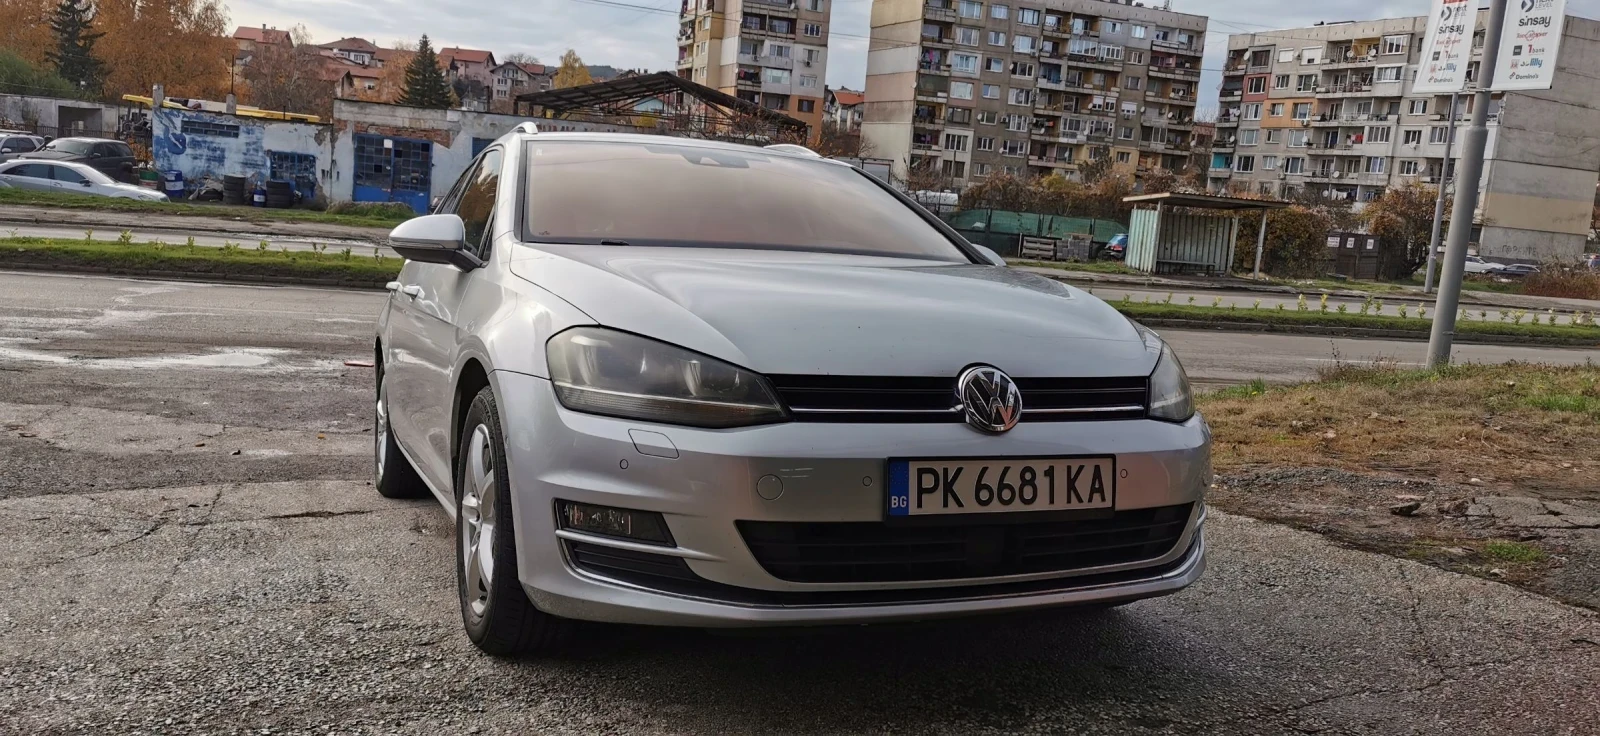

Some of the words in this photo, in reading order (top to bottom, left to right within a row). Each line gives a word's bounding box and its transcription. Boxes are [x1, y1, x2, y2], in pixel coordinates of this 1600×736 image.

[1518, 16, 1552, 28] sinsay
[1438, 24, 1465, 35] sinsay
[1530, 57, 1543, 68] lilly
[916, 467, 964, 508] PK
[974, 465, 1055, 507] 6681
[1066, 464, 1106, 504] KA
[891, 496, 907, 508] BG
